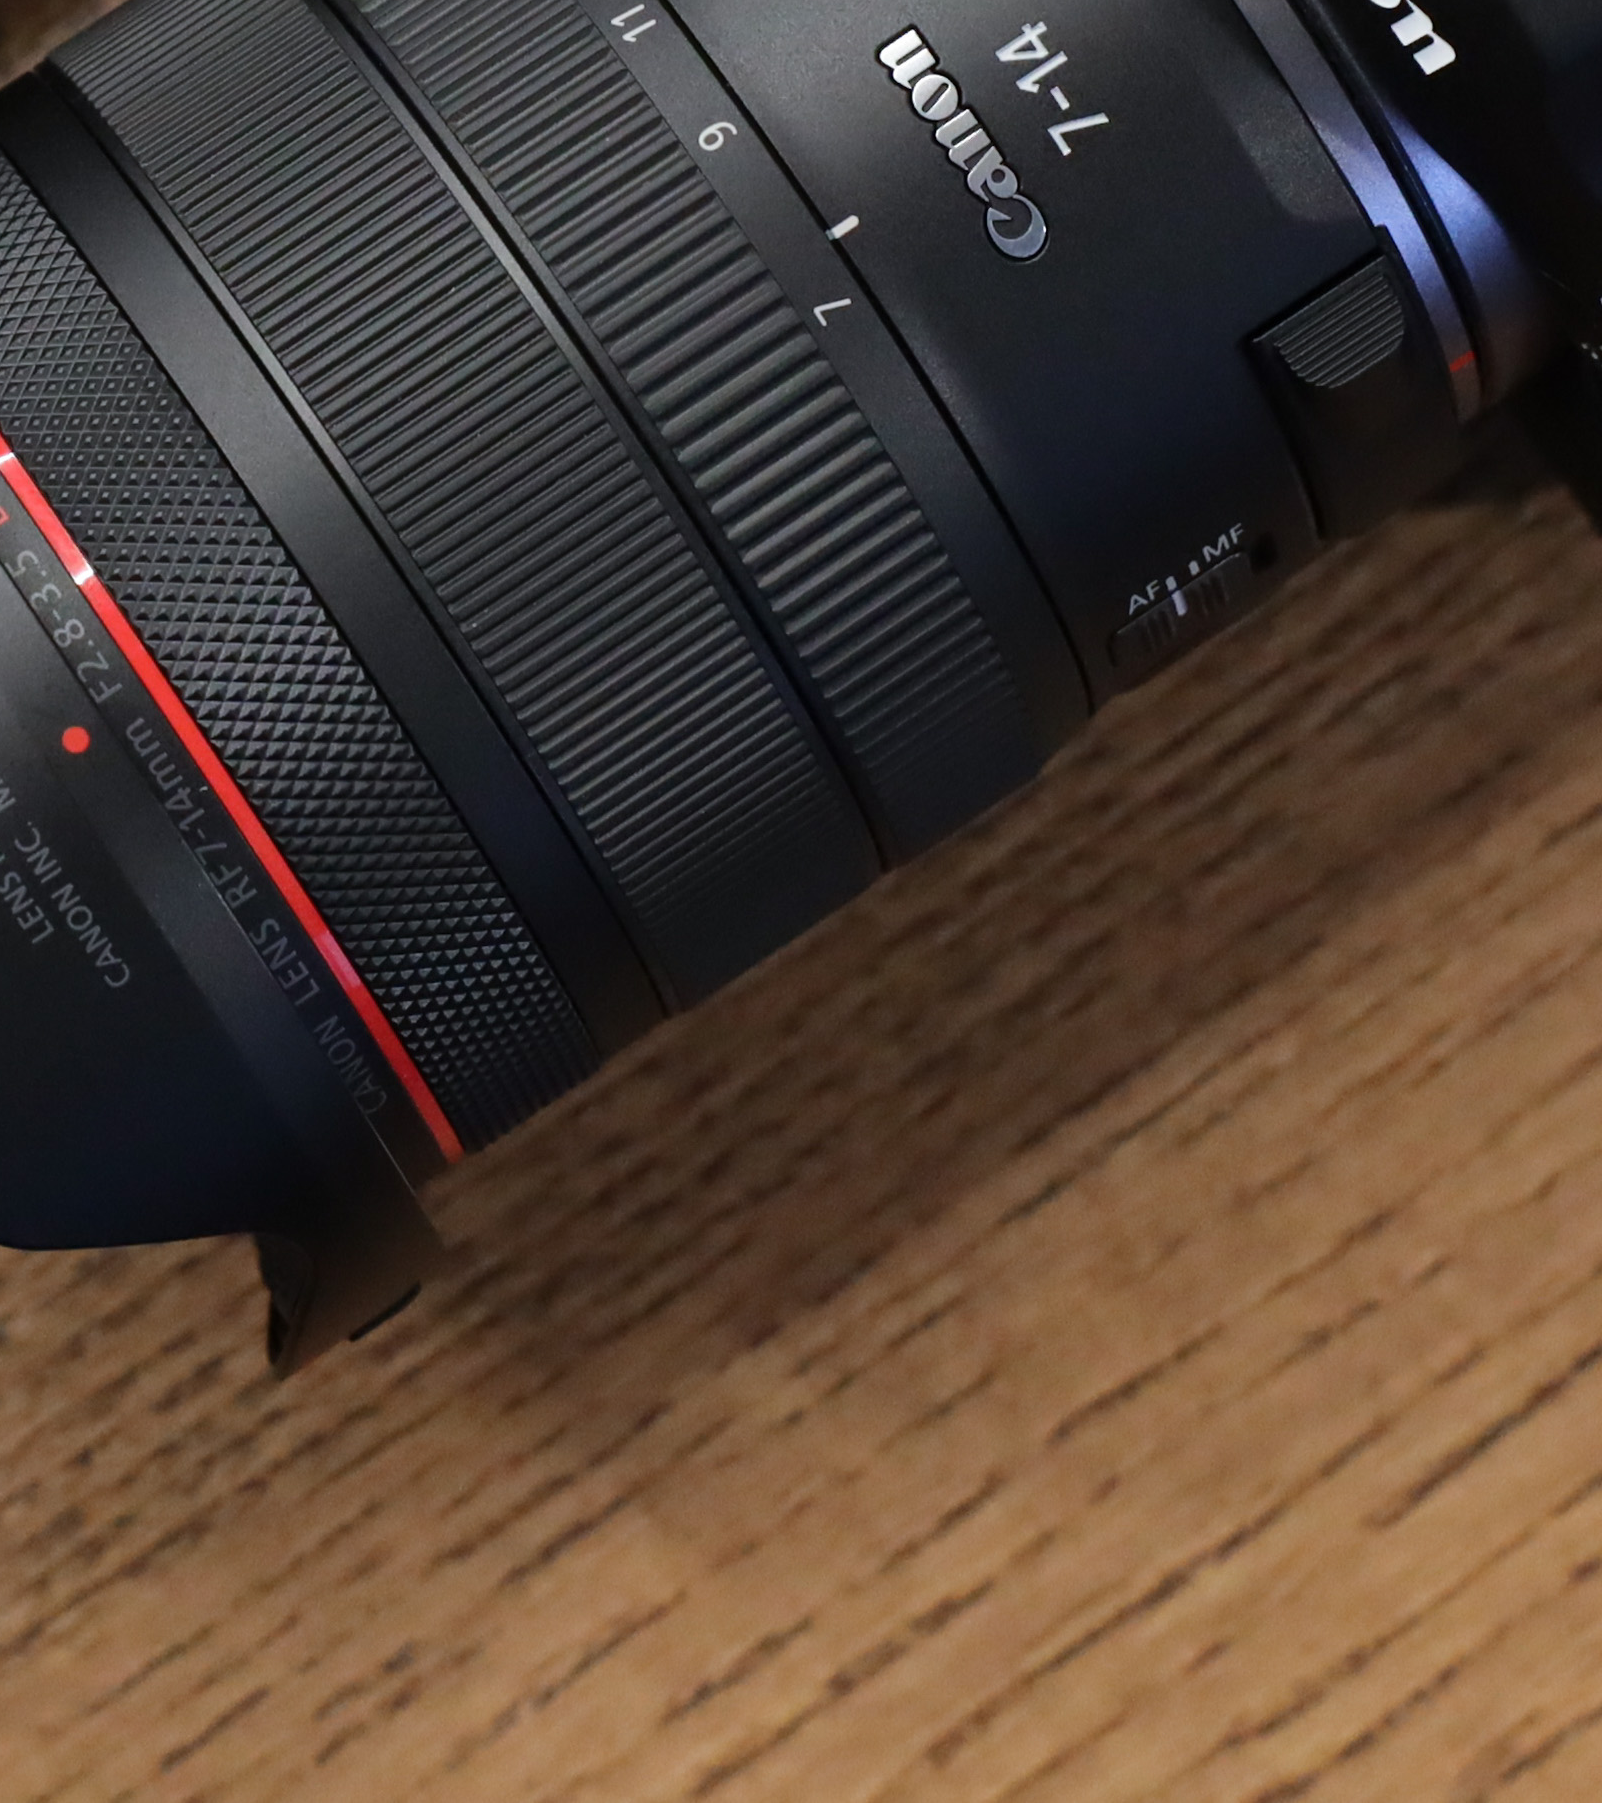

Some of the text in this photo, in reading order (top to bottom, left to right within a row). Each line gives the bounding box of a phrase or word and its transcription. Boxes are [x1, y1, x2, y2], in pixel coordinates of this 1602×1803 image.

[879, 28, 1049, 260] Canon
[994, 21, 1110, 156] 7-14
[610, 3, 657, 43] 11
[813, 298, 852, 327] 7
[1128, 579, 1161, 616] AF
[1202, 522, 1244, 563] MF
[4, 549, 123, 704] F2.8-3.5
[14, 820, 63, 885] INC.
[125, 717, 258, 910] RF7-14mm
[50, 882, 131, 988] CANON
[248, 918, 321, 1006] LENS
